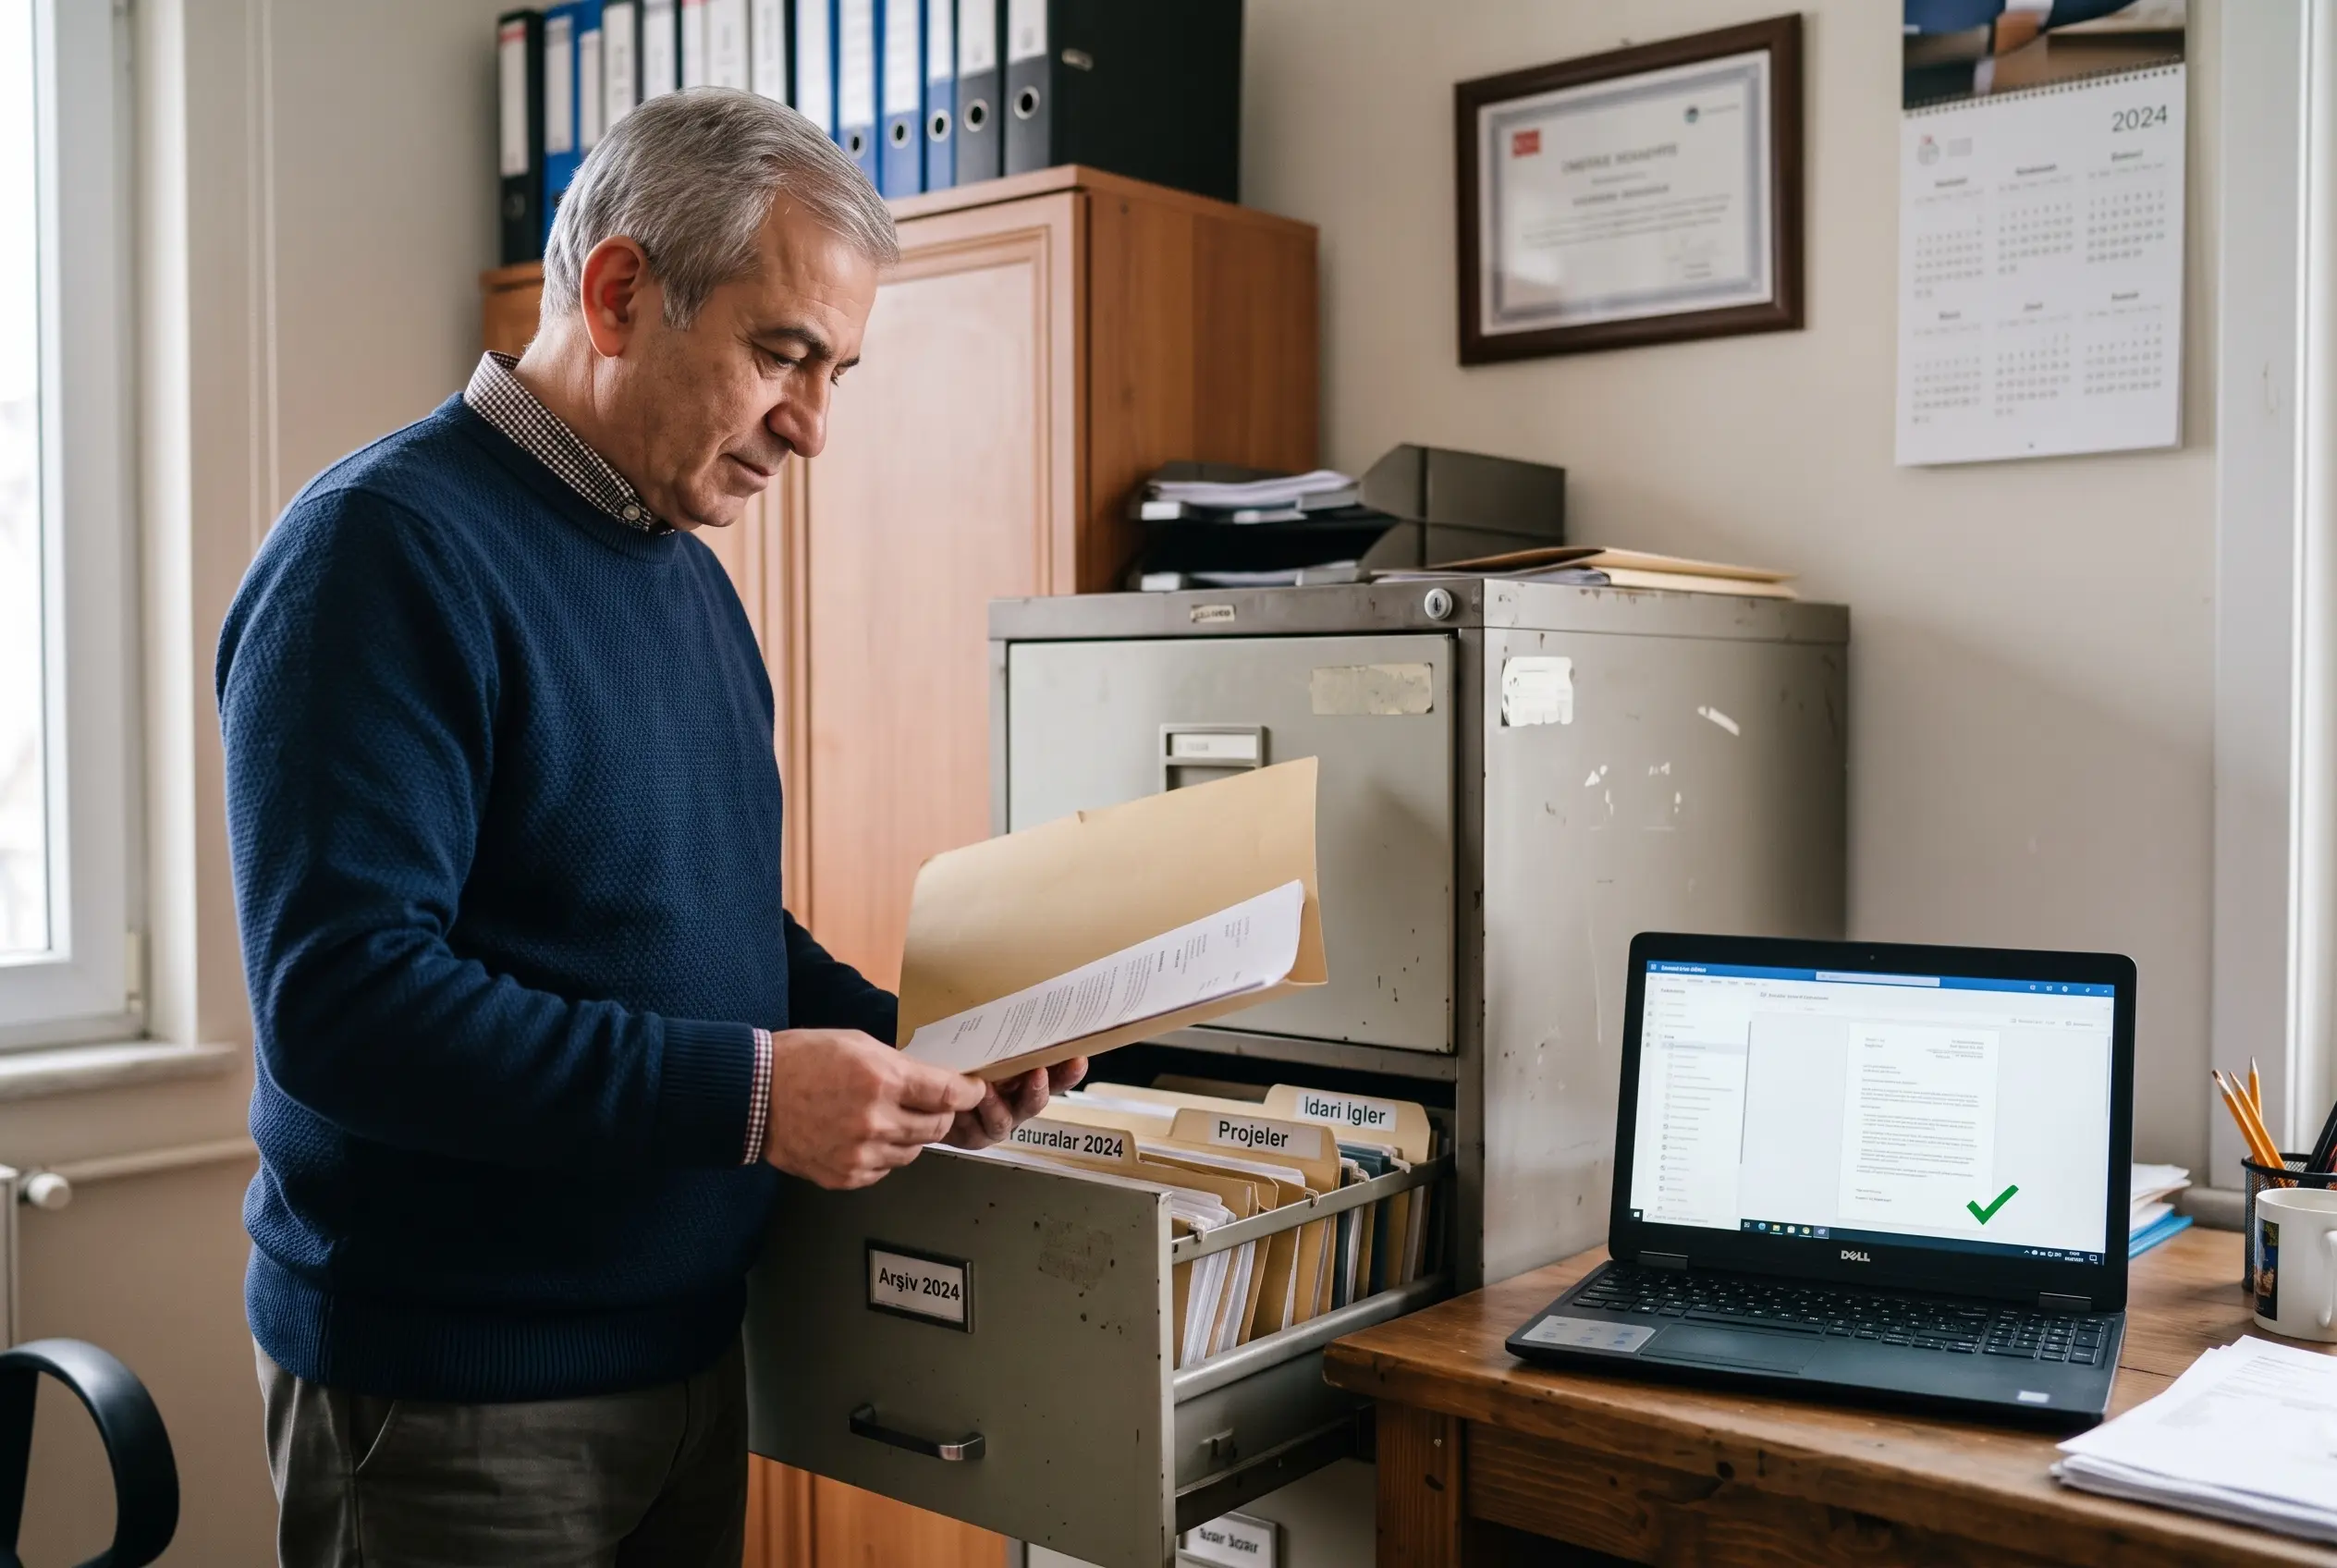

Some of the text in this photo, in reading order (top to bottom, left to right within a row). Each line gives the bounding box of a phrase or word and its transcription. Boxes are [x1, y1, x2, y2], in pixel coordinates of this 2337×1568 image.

[2111, 104, 2167, 133] 2024
[1083, 1134, 1123, 1158] 2024
[1218, 1120, 1289, 1147] Projeler
[1841, 1250, 1871, 1263] DELL
[878, 1267, 960, 1301] Arşiv 2024
